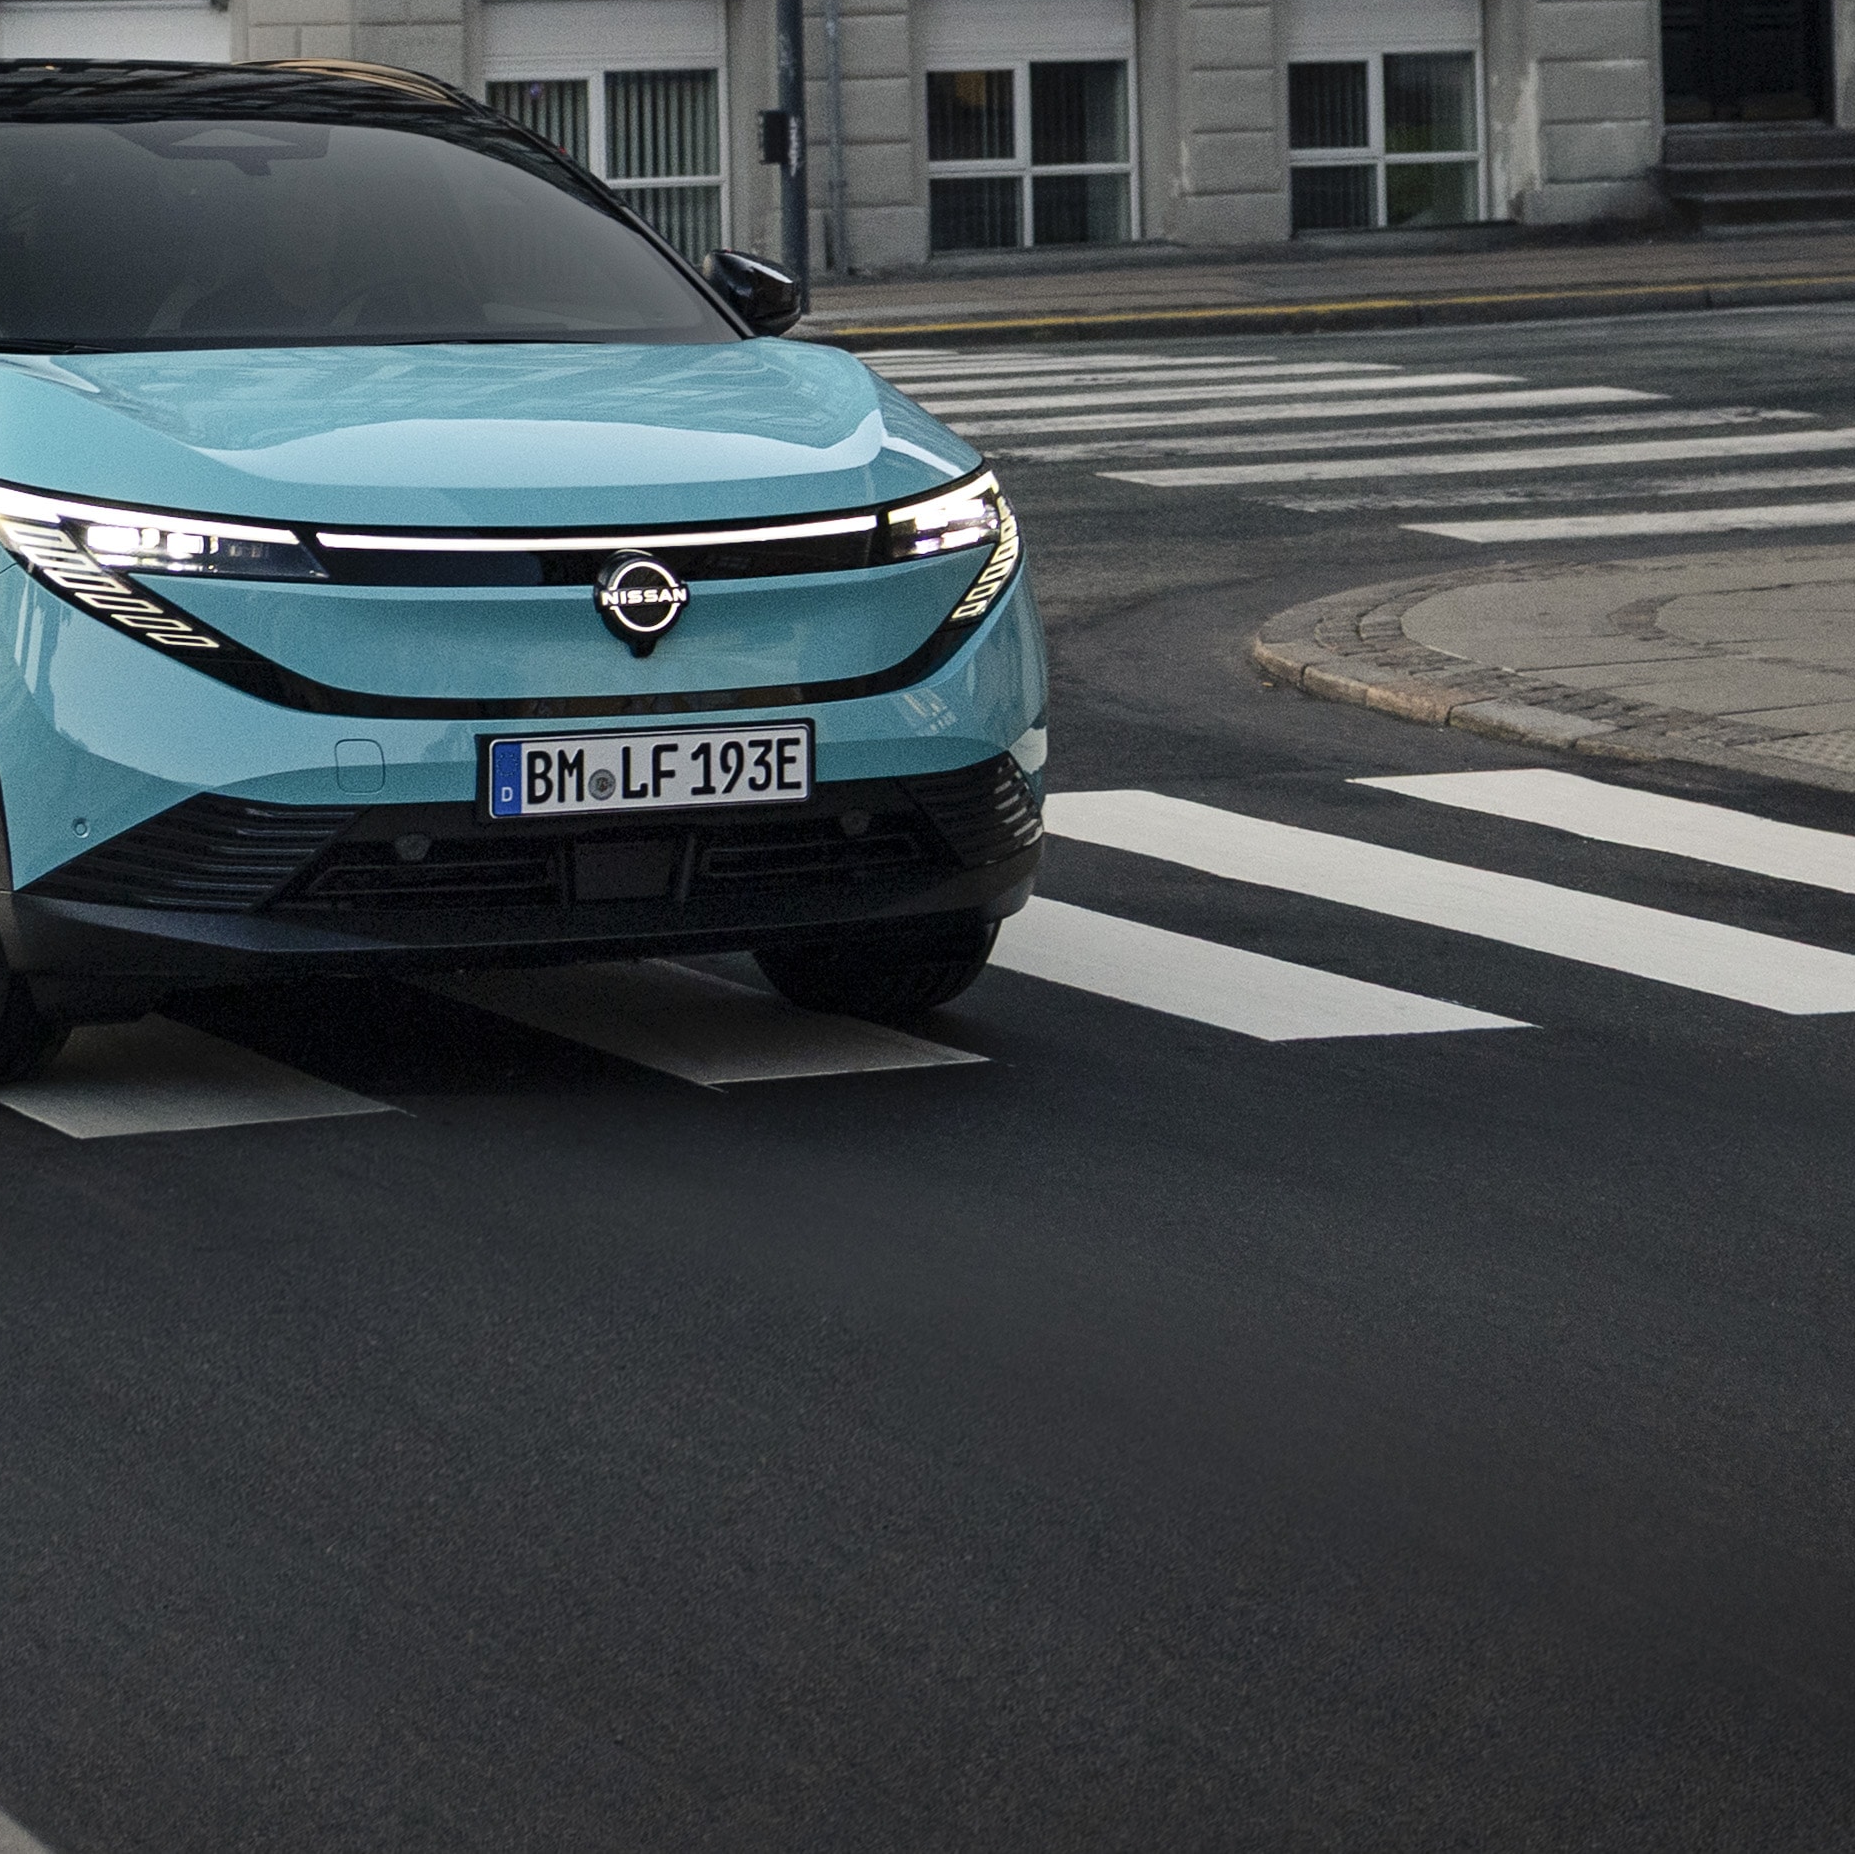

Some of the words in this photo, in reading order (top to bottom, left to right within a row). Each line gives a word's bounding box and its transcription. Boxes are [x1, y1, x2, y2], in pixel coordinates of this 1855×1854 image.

[601, 588, 687, 606] NISSAN
[526, 748, 585, 805] BM
[621, 743, 679, 799] LF
[690, 737, 802, 796] 193E
[501, 786, 513, 802] D
